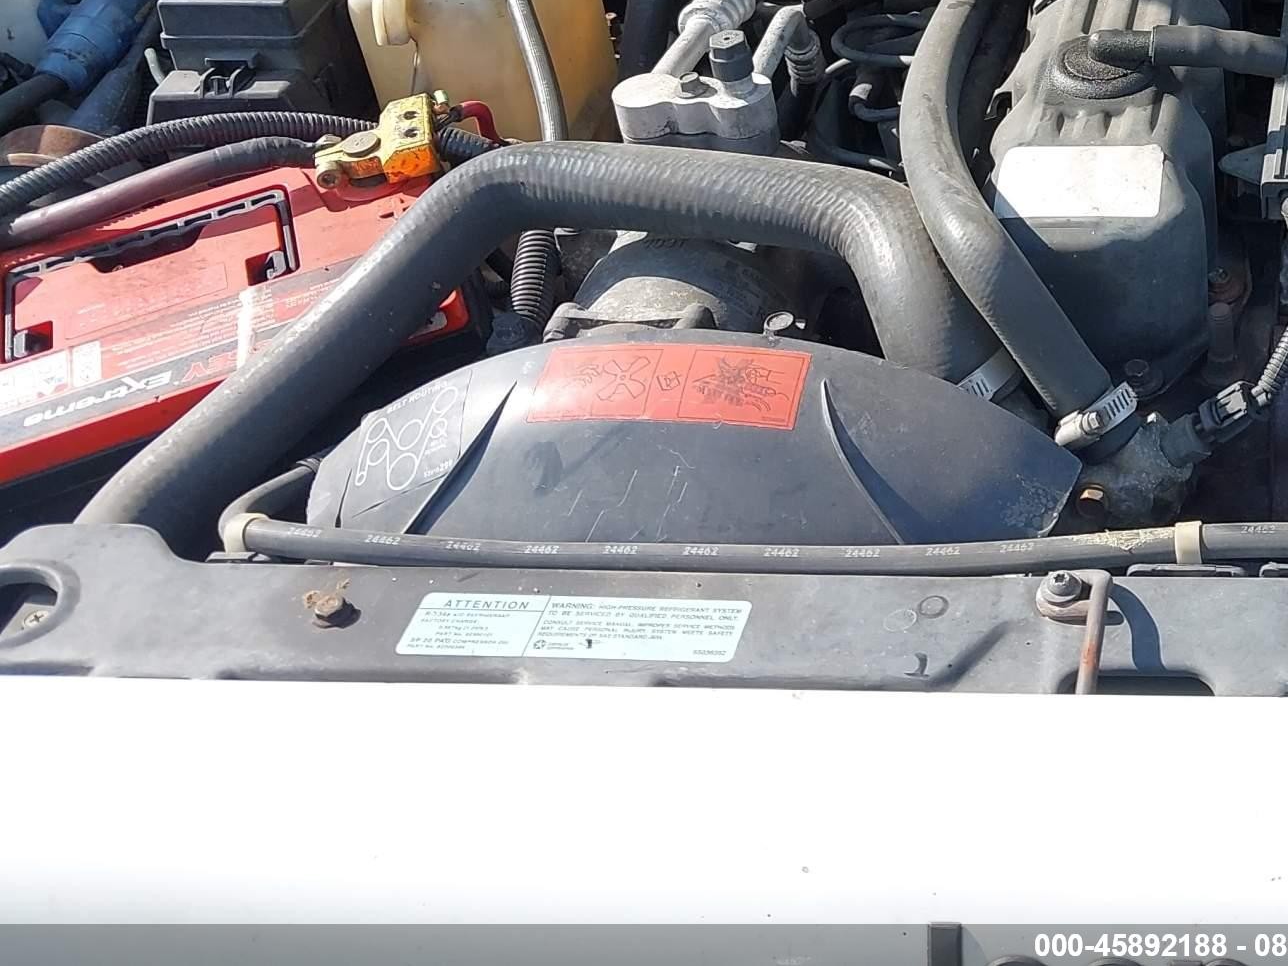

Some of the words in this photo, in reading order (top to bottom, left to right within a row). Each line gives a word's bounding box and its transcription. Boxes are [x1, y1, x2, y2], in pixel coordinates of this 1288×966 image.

[23, 369, 173, 428] Extreme
[364, 535, 400, 545] 24462
[524, 544, 560, 555] 24462
[602, 544, 638, 555] 24462
[683, 545, 720, 556] 24462
[926, 546, 961, 556] 24462
[443, 599, 530, 610] ATTENTION
